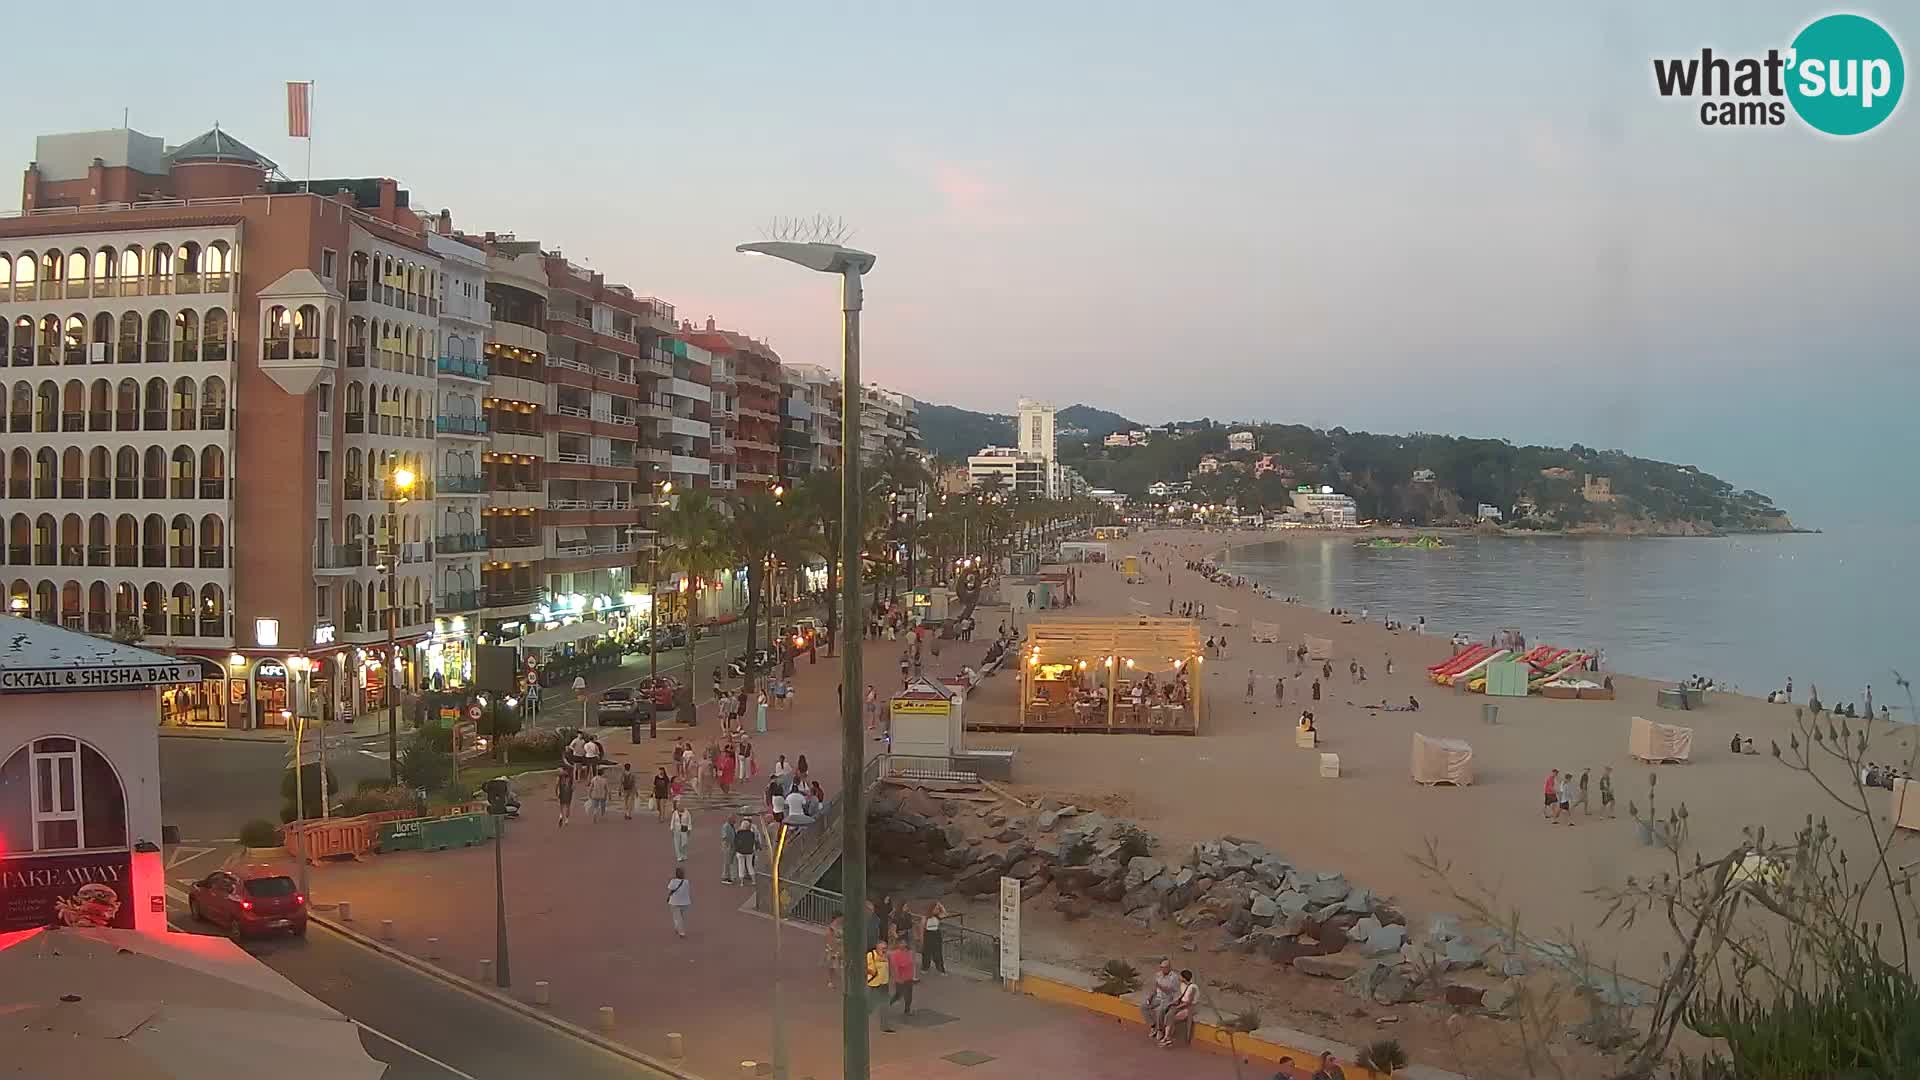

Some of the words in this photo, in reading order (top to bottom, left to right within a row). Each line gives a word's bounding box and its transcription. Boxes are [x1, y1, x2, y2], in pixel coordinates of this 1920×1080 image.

[3, 673, 60, 687] CKTAIL
[66, 672, 76, 684] &
[81, 669, 142, 684] SHISHA
[148, 667, 180, 682] BAR
[2, 864, 123, 889] TAKEAWAY
